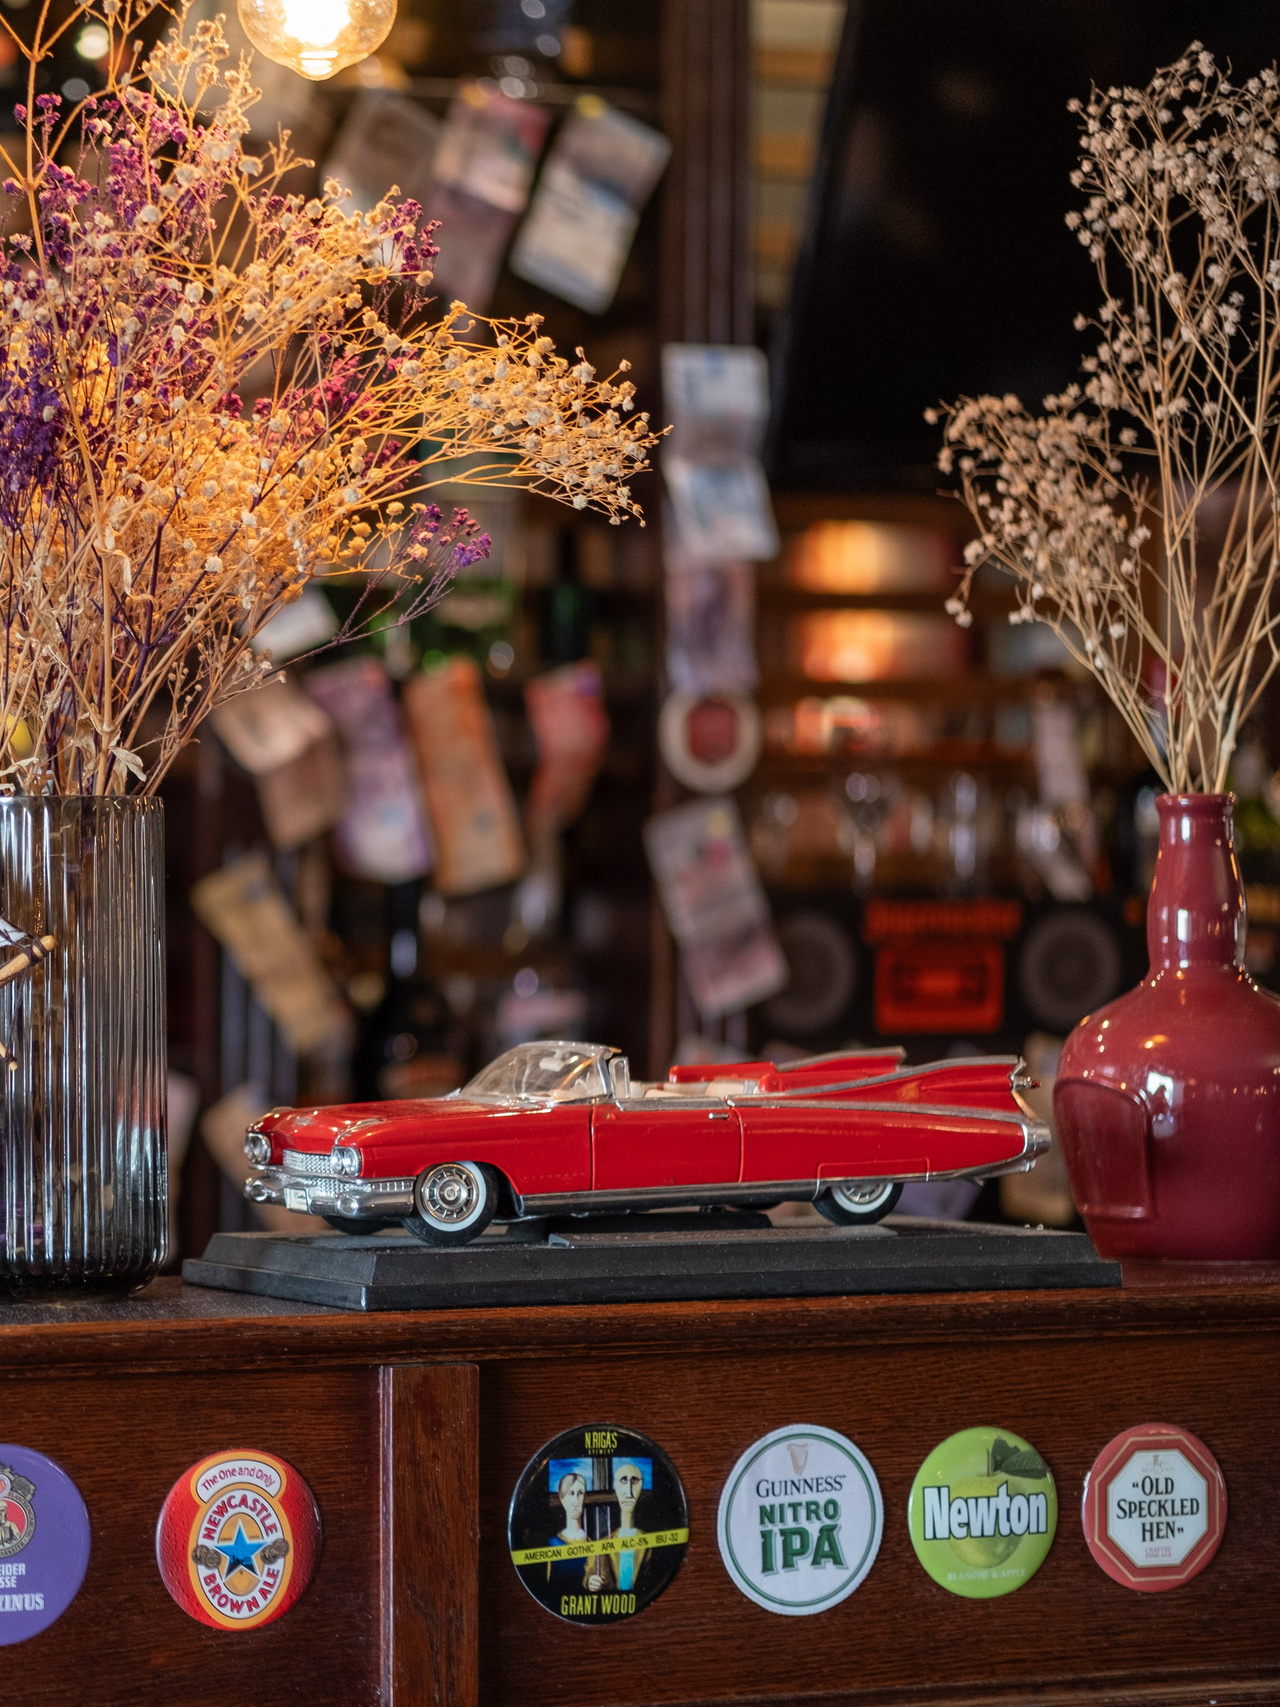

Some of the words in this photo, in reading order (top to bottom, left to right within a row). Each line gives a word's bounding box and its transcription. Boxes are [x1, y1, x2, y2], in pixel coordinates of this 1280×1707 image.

[201, 1474, 219, 1491] The
[219, 1467, 237, 1480] One
[238, 1466, 256, 1477] and
[255, 1468, 276, 1488] Only
[202, 1493, 279, 1541] NEWCASTLE
[759, 1498, 841, 1527] NITRO
[922, 1480, 1048, 1541] Newton
[1116, 1498, 1200, 1519] SPECKLED
[524, 1548, 562, 1562] AMERICAN
[567, 1544, 595, 1556] GOTHIC
[601, 1542, 615, 1552] APA
[760, 1523, 849, 1577] IPA
[203, 1572, 261, 1614] BROWN
[258, 1568, 280, 1601] ALE
[561, 1594, 598, 1616] GRANT
[601, 1593, 636, 1615] WOOD
